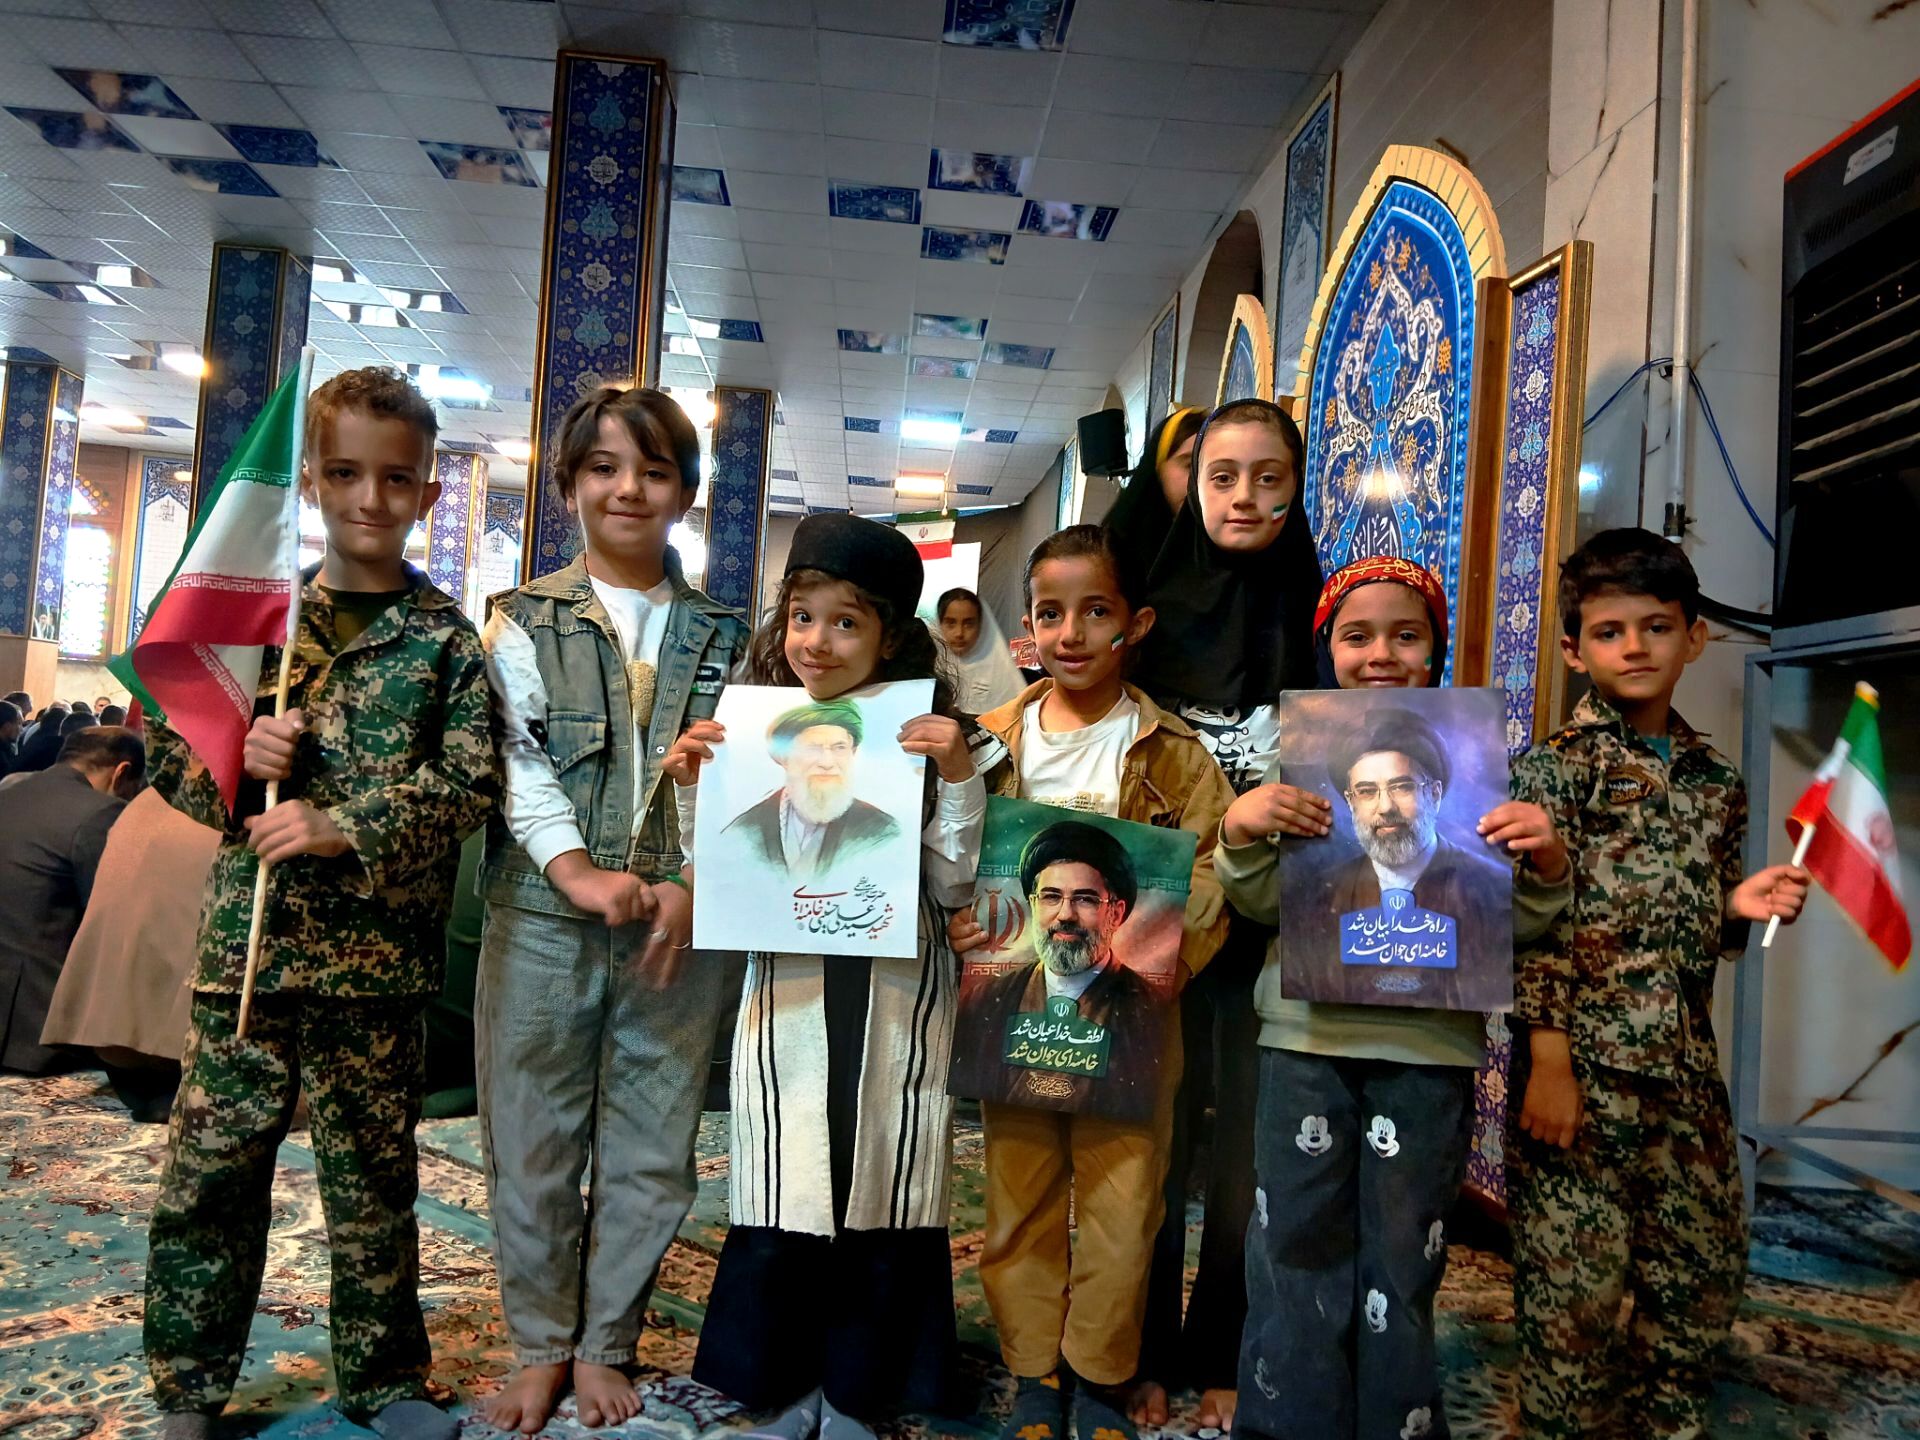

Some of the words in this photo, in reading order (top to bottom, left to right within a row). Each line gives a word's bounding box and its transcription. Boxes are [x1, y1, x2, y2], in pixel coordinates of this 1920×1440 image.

[1347, 913, 1365, 931] شد
[1363, 914, 1390, 939] بیان
[1429, 917, 1448, 934] راه
[1379, 942, 1408, 964] جوان
[1010, 1018, 1031, 1037] شد
[1029, 1020, 1055, 1041] عیان
[1055, 1022, 1071, 1041] خدا
[1068, 1028, 1104, 1044] لطف
[1007, 1041, 1029, 1060] شد
[1027, 1046, 1055, 1066] جوان
